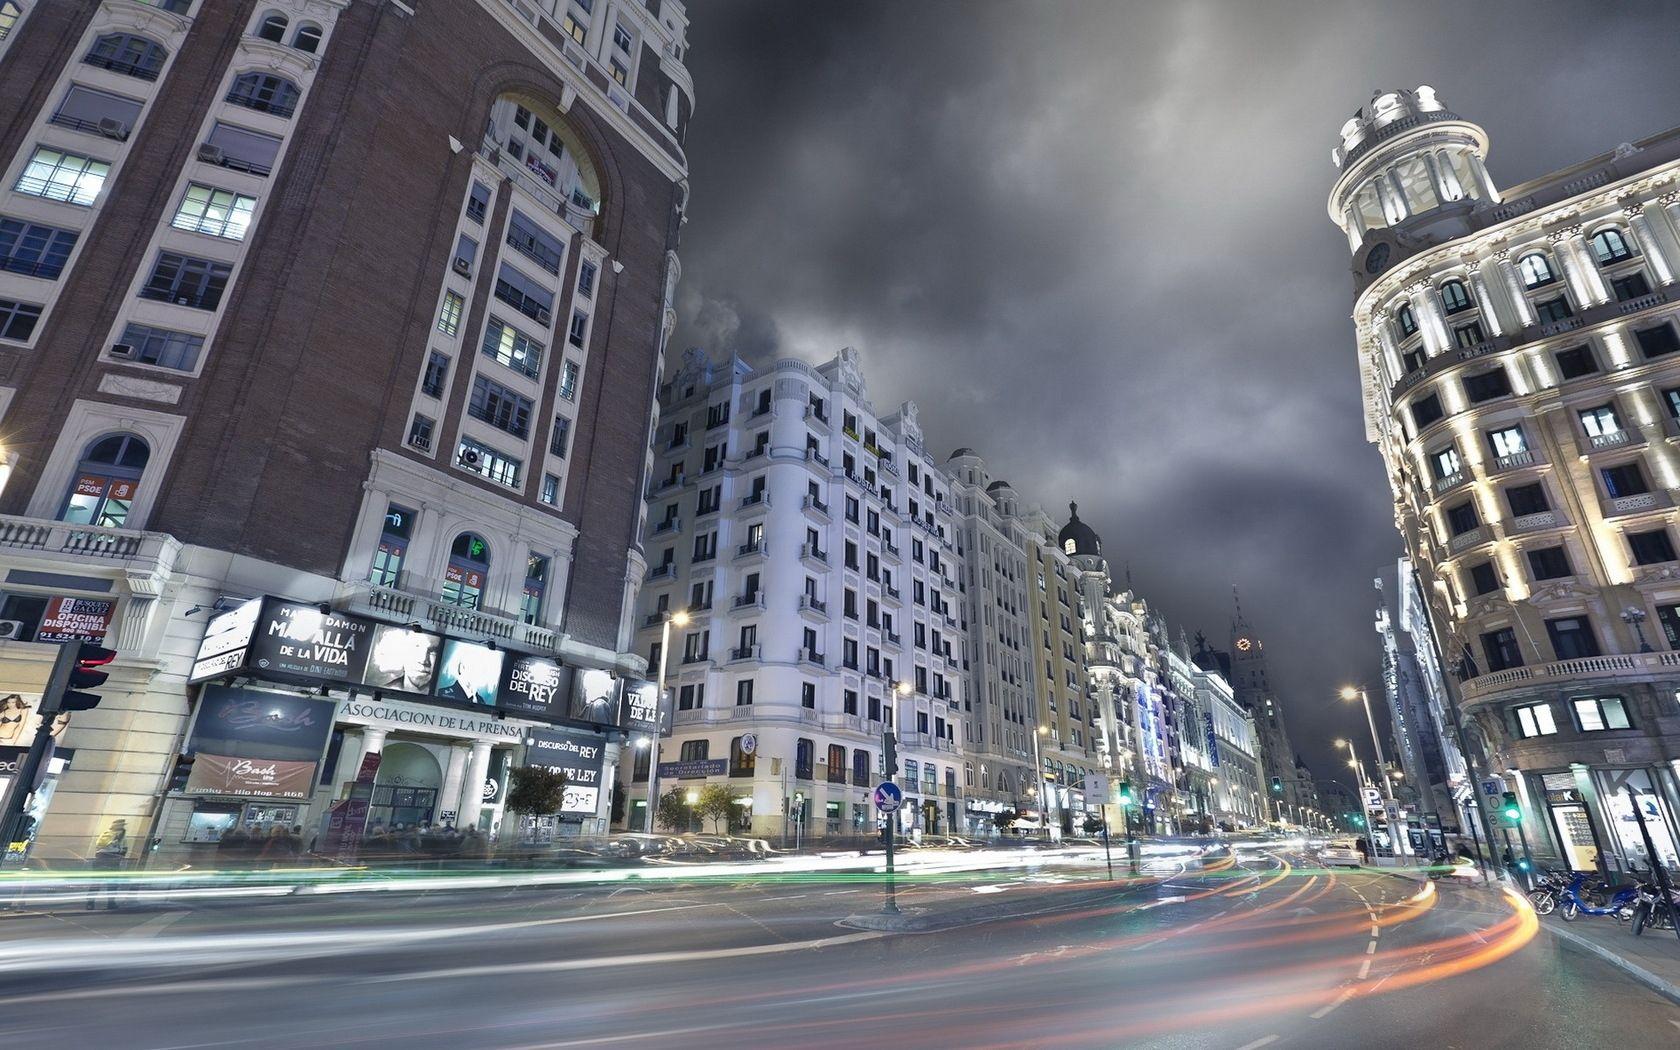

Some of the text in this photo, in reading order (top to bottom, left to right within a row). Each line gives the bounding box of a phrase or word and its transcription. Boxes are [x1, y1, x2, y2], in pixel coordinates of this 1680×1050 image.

[78, 484, 103, 494] PSOE
[57, 612, 105, 624] OFICINA
[326, 617, 367, 633] DAMON
[225, 652, 243, 669] REY
[280, 645, 348, 666] DE LA VIDA
[509, 680, 557, 704] DEL REY
[340, 703, 523, 738] ASOCIACION DE LA PRENSA
[630, 706, 644, 720] DE
[538, 740, 568, 751] DISCURSO
[569, 744, 579, 753] DEL
[579, 746, 598, 759] REY
[232, 759, 276, 775] Bash
[577, 769, 597, 782] LEY
[1367, 789, 1380, 805] P
